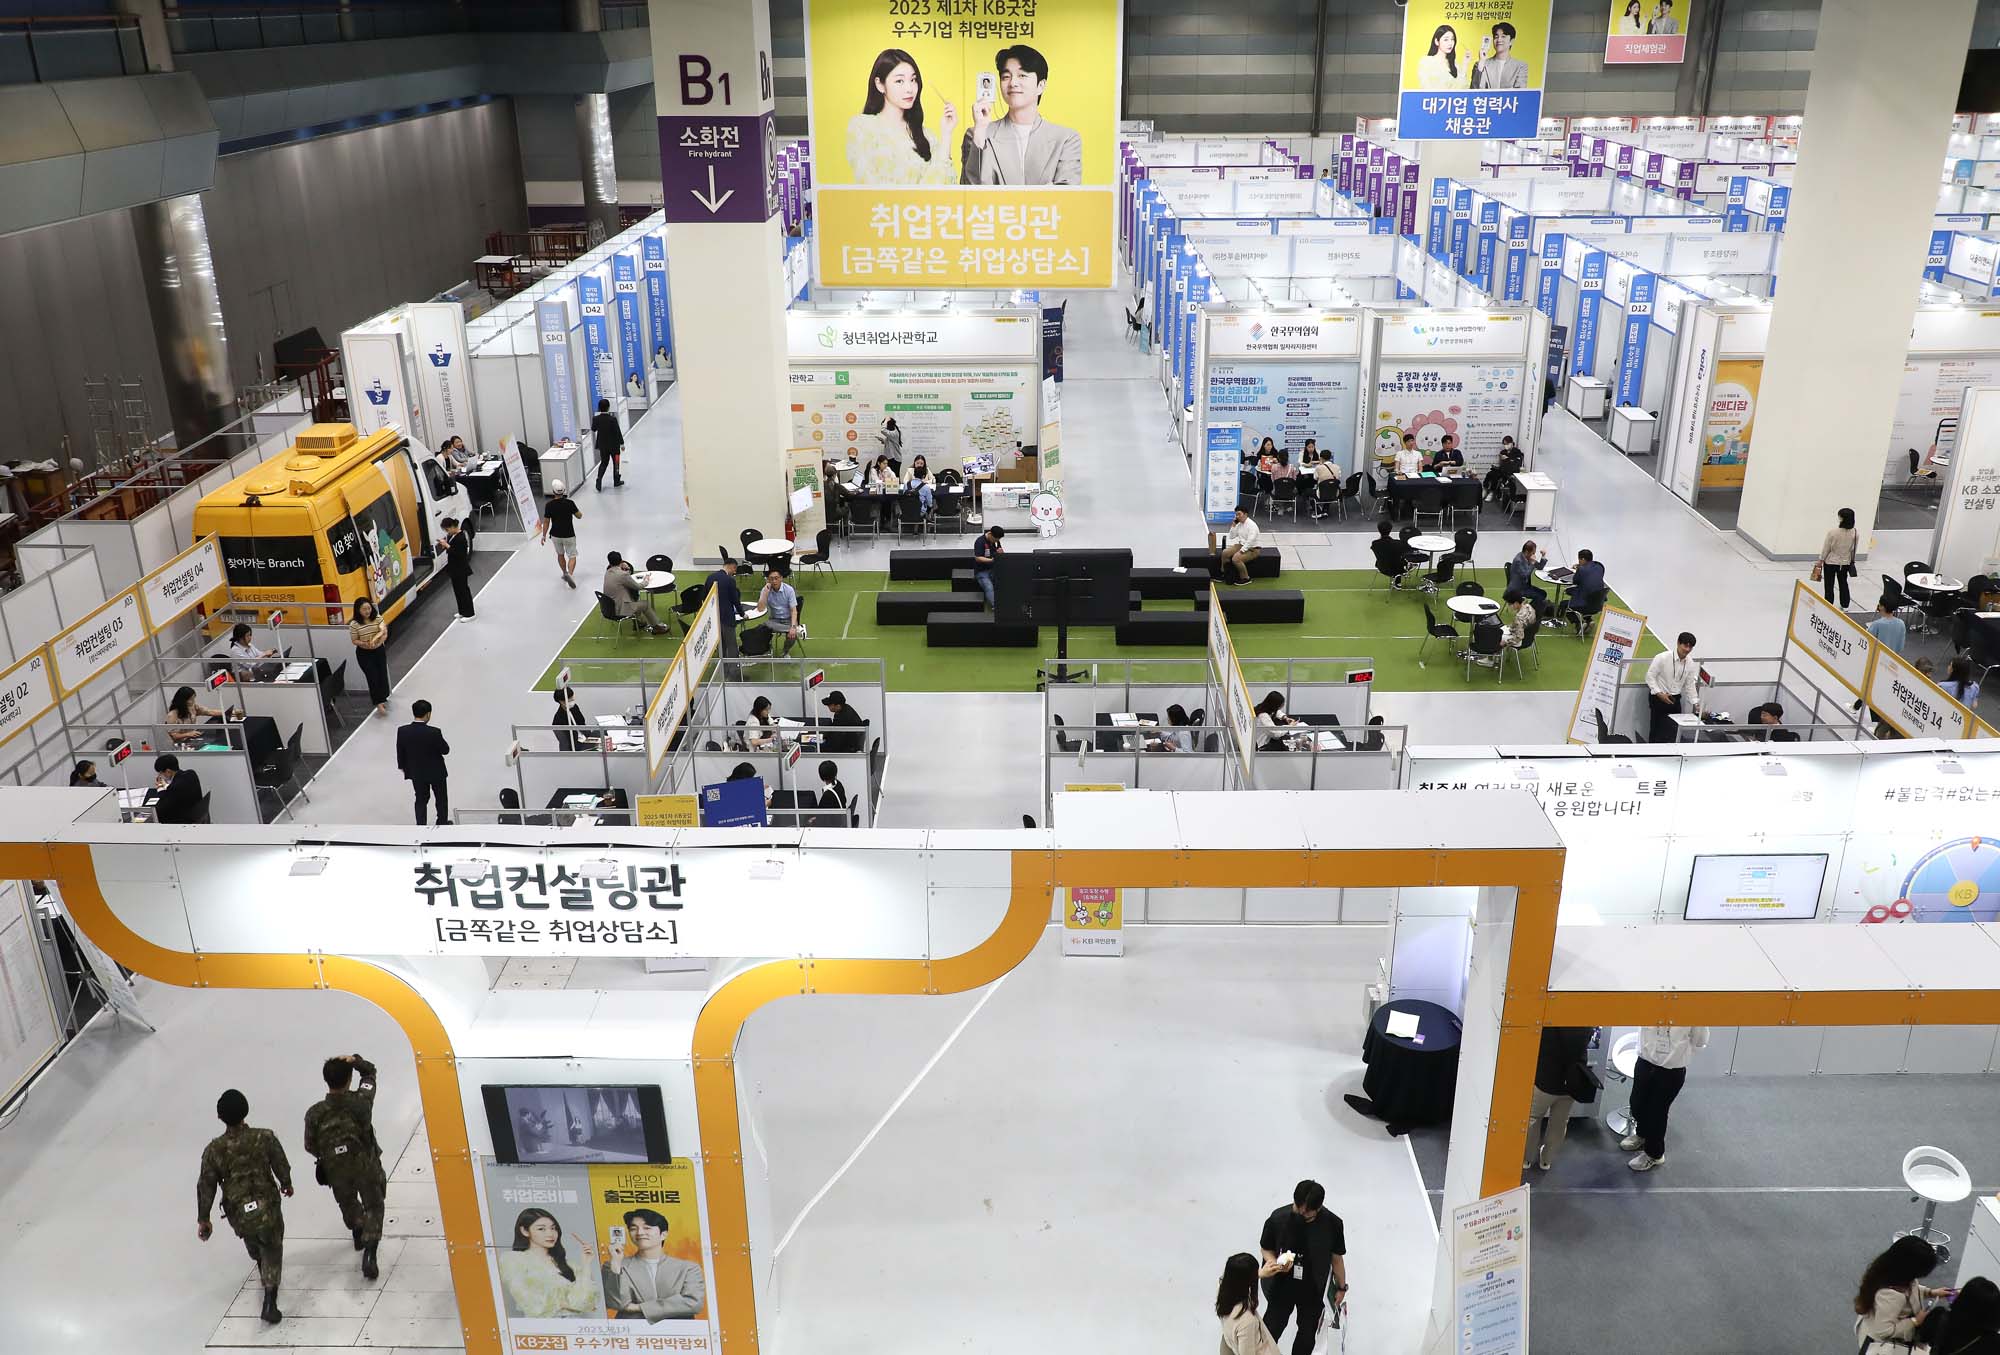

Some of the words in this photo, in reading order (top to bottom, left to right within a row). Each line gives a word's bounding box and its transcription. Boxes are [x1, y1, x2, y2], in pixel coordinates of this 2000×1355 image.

[889, 1, 932, 15] 2023
[936, 0, 978, 16] 제1차
[984, 0, 1037, 16] KB굿잡
[1445, 1, 1465, 9] 2023
[1466, 1, 1486, 9] 제1차
[1445, 12, 1474, 20] 우수기업
[1475, 12, 1512, 20] 취업박람회
[892, 21, 953, 38] 우수기업
[958, 21, 1035, 38] 취업박람회
[1624, 43, 1666, 54] 직업체험관
[678, 54, 731, 106] B1
[1422, 96, 1468, 114] 대기업
[1473, 96, 1519, 114] 협력사
[1445, 117, 1492, 135] 채용관
[679, 126, 740, 149] 소화전
[704, 150, 732, 159] hydrant
[870, 204, 1061, 240] 취업컨설팅관
[649, 261, 663, 269] D44
[841, 246, 949, 276] [금쪽같은
[958, 245, 1090, 277] 취업상담소]
[619, 283, 634, 291] D43
[585, 306, 601, 314] D42
[842, 331, 938, 345] 청년취업사관학교
[1270, 325, 1319, 337] 한국무역협회
[436, 343, 445, 365] TIPA
[1246, 343, 1279, 351] 한국무역협회
[789, 374, 815, 383] 관학교
[1210, 377, 1265, 386] 한국무역협회가
[1396, 371, 1420, 380] 공정과
[1421, 371, 1441, 381] 상생,
[372, 378, 383, 403] TIPA
[1379, 382, 1404, 391] 한민국
[1406, 382, 1438, 392] 동반성장
[1440, 382, 1464, 392] 플랫폼
[1962, 485, 1978, 495] KB
[1963, 498, 1996, 510] 컨설팅
[332, 540, 345, 558] KB
[226, 557, 266, 570] 찾아가는
[268, 557, 305, 570] Branch
[162, 567, 195, 598] 취업컨설팅
[195, 561, 204, 577] 04
[124, 595, 133, 608] J03
[245, 594, 261, 602] KB
[261, 593, 296, 602] 국민은행
[75, 625, 113, 658] 취업컨설팅
[112, 617, 124, 633] 03
[1810, 613, 1842, 649] 취업컨설팅
[1842, 639, 1852, 656] 13
[1857, 637, 1868, 650] J13
[30, 658, 41, 672] J02
[16, 682, 29, 700] 02
[1891, 680, 1932, 721] 취업컨설팅
[1931, 711, 1943, 731] 14
[1950, 710, 1963, 726] J14
[1547, 781, 1595, 797] 새로운
[1553, 800, 1642, 817] 응원합니다!
[414, 862, 687, 911] 취업컨설팅관
[435, 917, 541, 943] [금쪽같은
[549, 918, 678, 944] 취업상담소]
[617, 1174, 664, 1189] 내일의
[604, 1190, 681, 1204] 출근준비로
[516, 1336, 566, 1350] KB굿잡
[574, 1337, 630, 1350] 우수기업
[635, 1337, 708, 1351] 취업박람회
